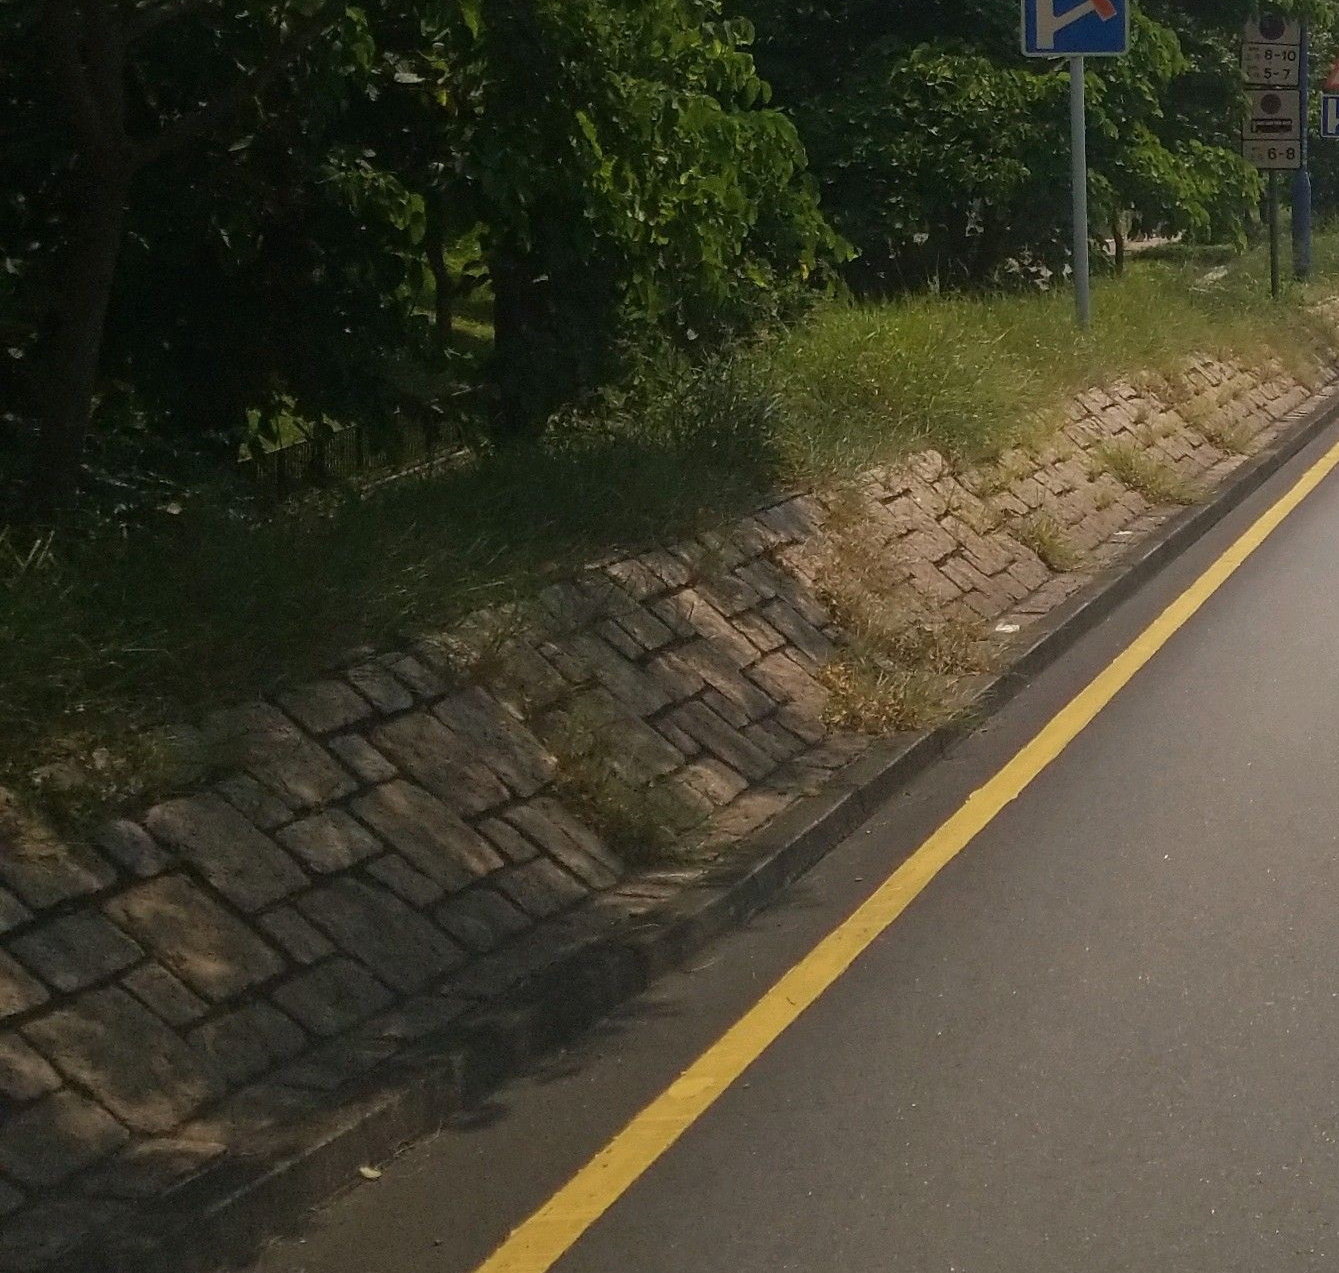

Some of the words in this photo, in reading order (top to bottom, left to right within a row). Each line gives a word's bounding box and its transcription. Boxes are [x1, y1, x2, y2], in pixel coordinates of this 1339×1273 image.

[1264, 49, 1296, 62] 8-10
[1264, 68, 1290, 79] 5-7
[1268, 147, 1295, 160] 6-8
